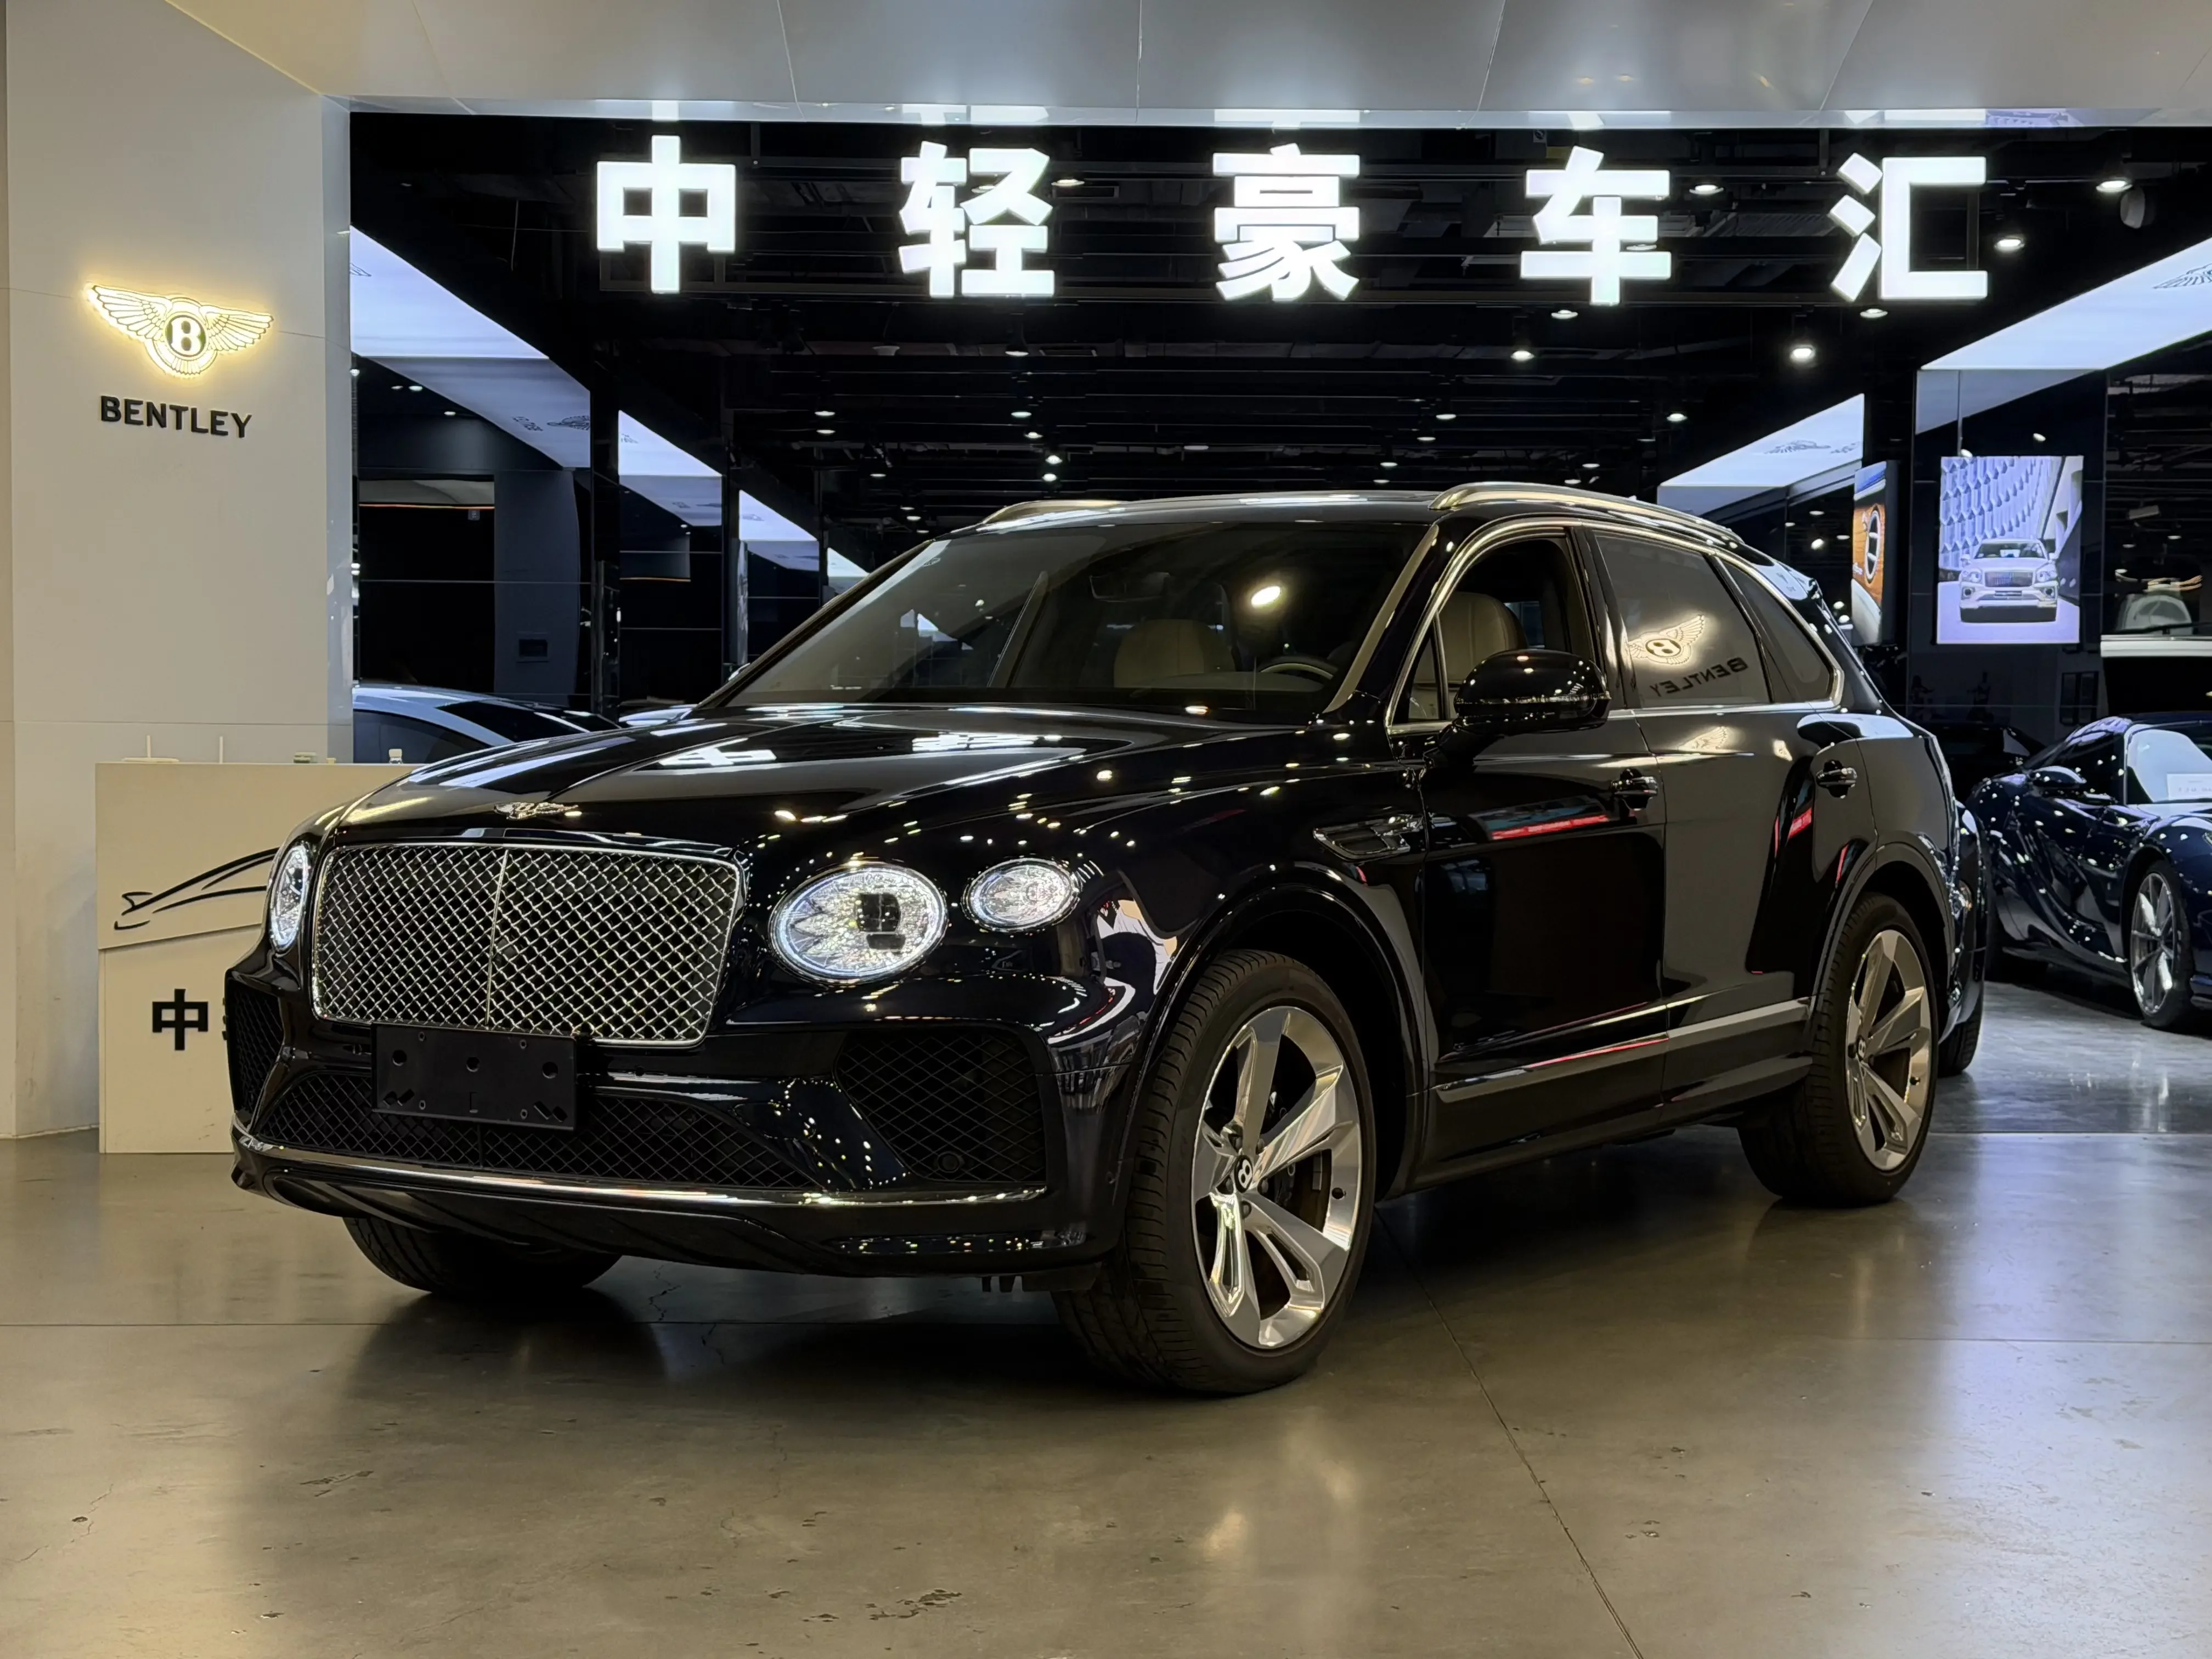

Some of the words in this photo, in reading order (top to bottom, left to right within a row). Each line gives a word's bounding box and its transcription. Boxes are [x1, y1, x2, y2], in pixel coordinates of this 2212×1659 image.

[596, 135, 1988, 306] 中轻豪车汇
[101, 395, 252, 438] BENTLEY
[152, 989, 208, 1051] 中
